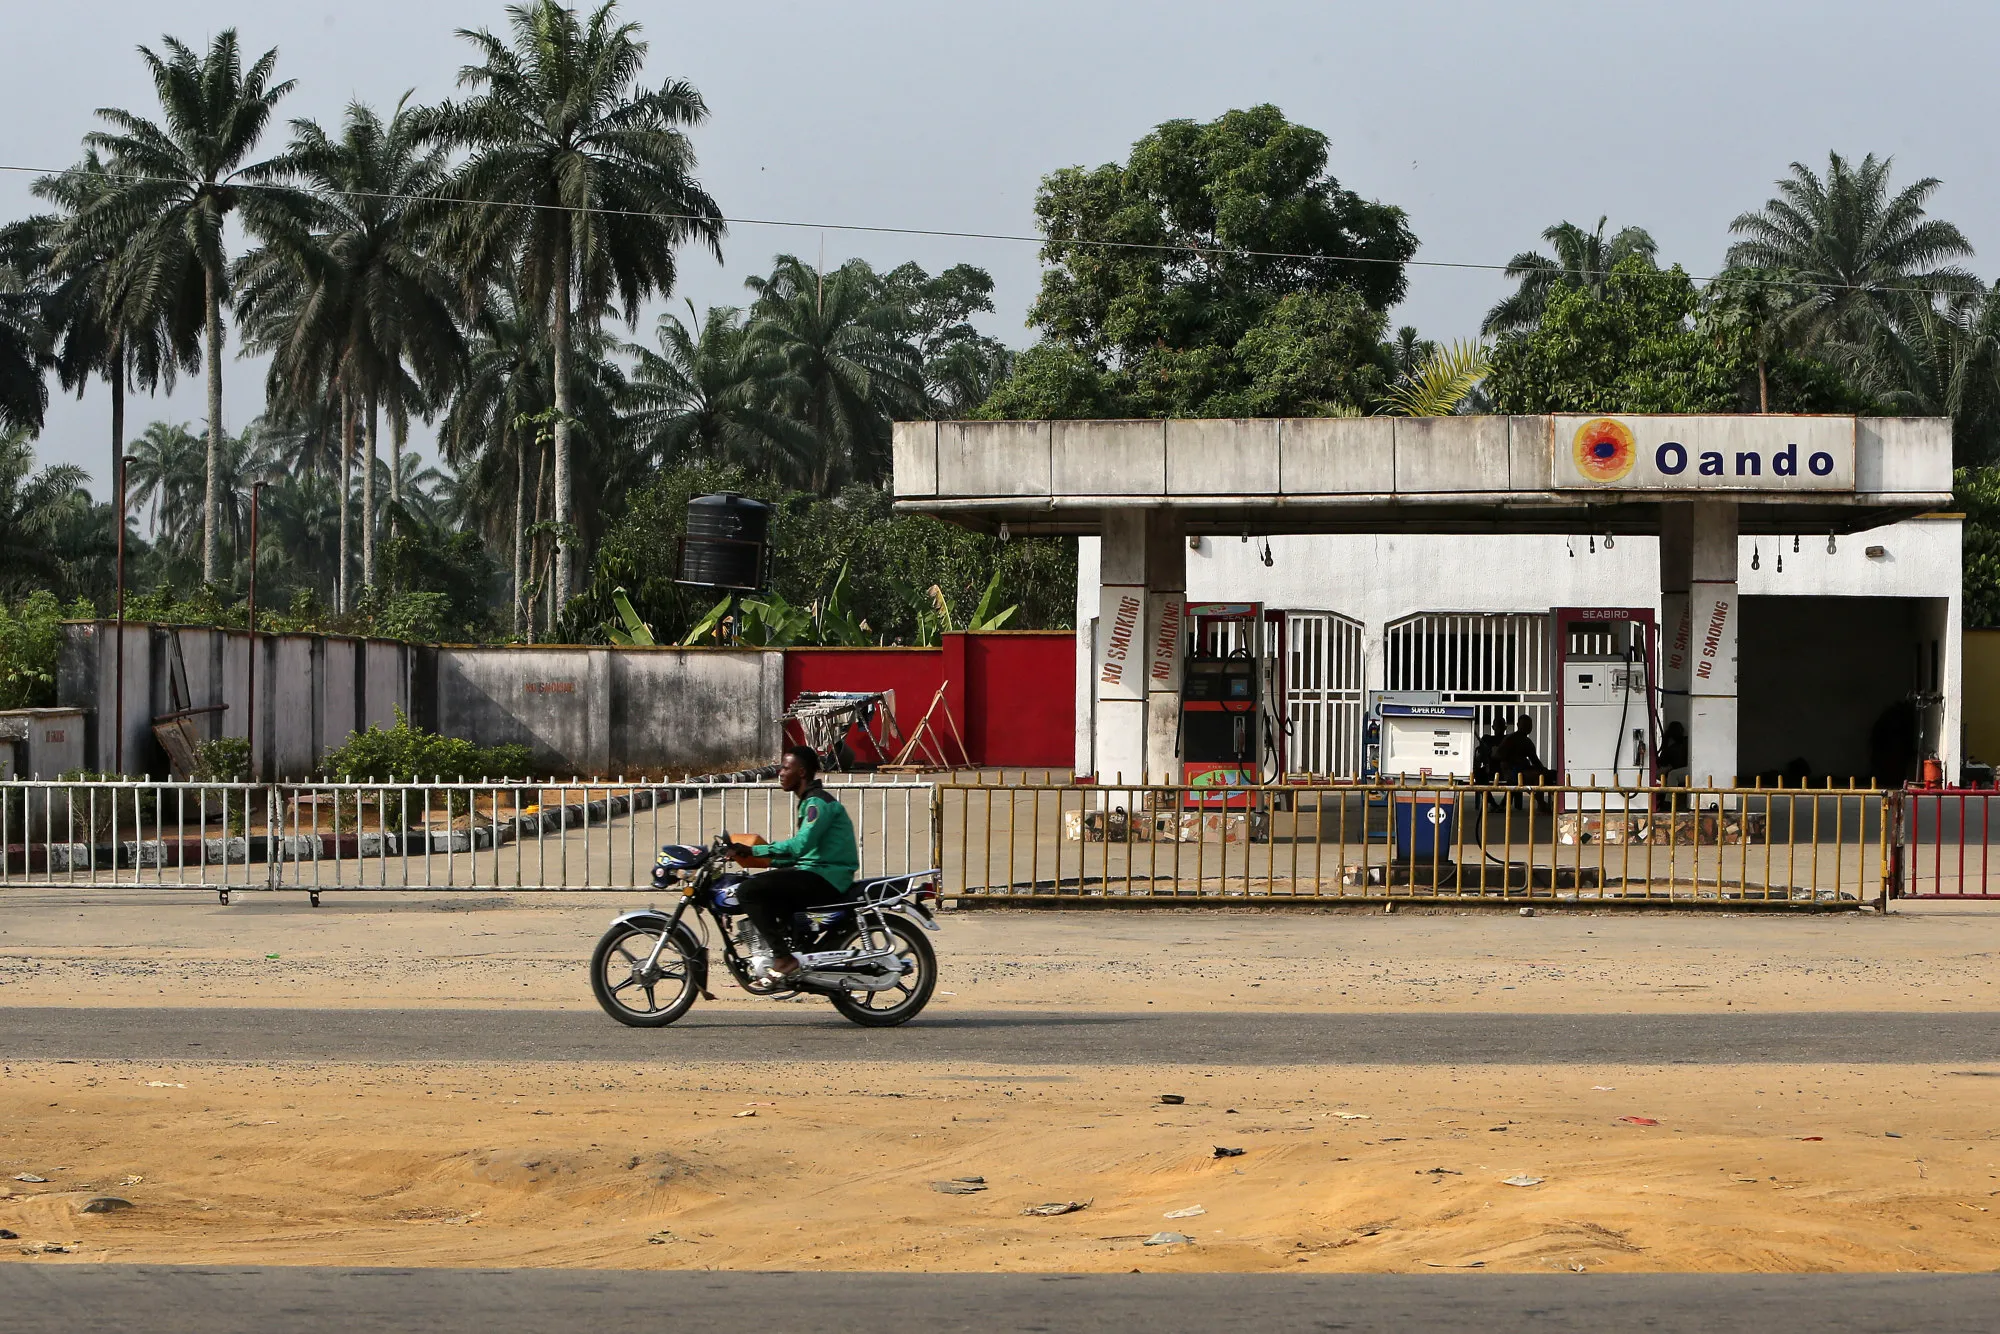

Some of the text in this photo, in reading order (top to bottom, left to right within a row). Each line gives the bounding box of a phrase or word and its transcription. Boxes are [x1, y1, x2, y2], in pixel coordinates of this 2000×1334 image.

[1655, 442, 1834, 476] Oando
[1100, 595, 1140, 685] NO SMOKING
[1152, 601, 1179, 680] NO SMOKING
[1582, 610, 1629, 619] SEABIRD
[1696, 600, 1729, 680] NO SMOKING
